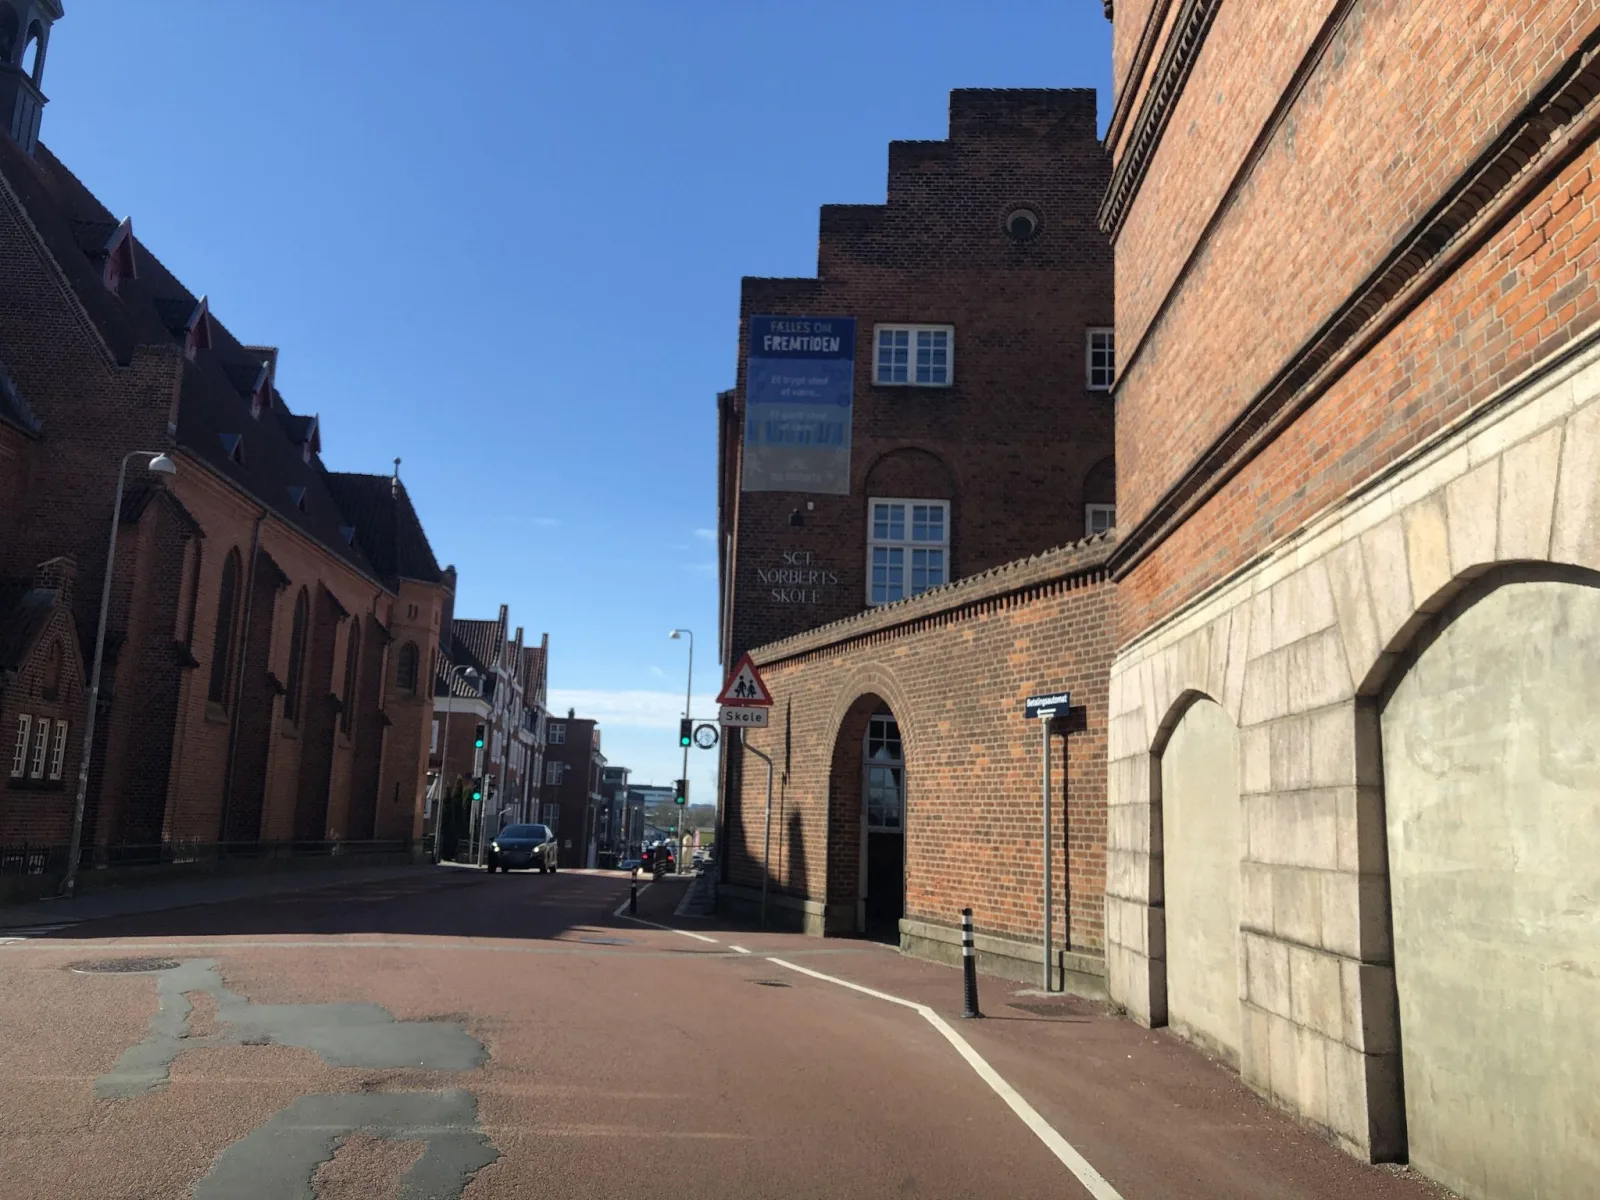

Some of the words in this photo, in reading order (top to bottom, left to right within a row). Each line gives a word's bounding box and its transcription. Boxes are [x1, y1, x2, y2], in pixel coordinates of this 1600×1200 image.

[770, 320, 811, 334] FÆLLES
[813, 322, 832, 334] OM
[757, 568, 838, 585] NORBERTS
[770, 588, 822, 604] SKOLE
[1026, 694, 1068, 707] Betalingsautomat
[725, 711, 763, 722] Skole
